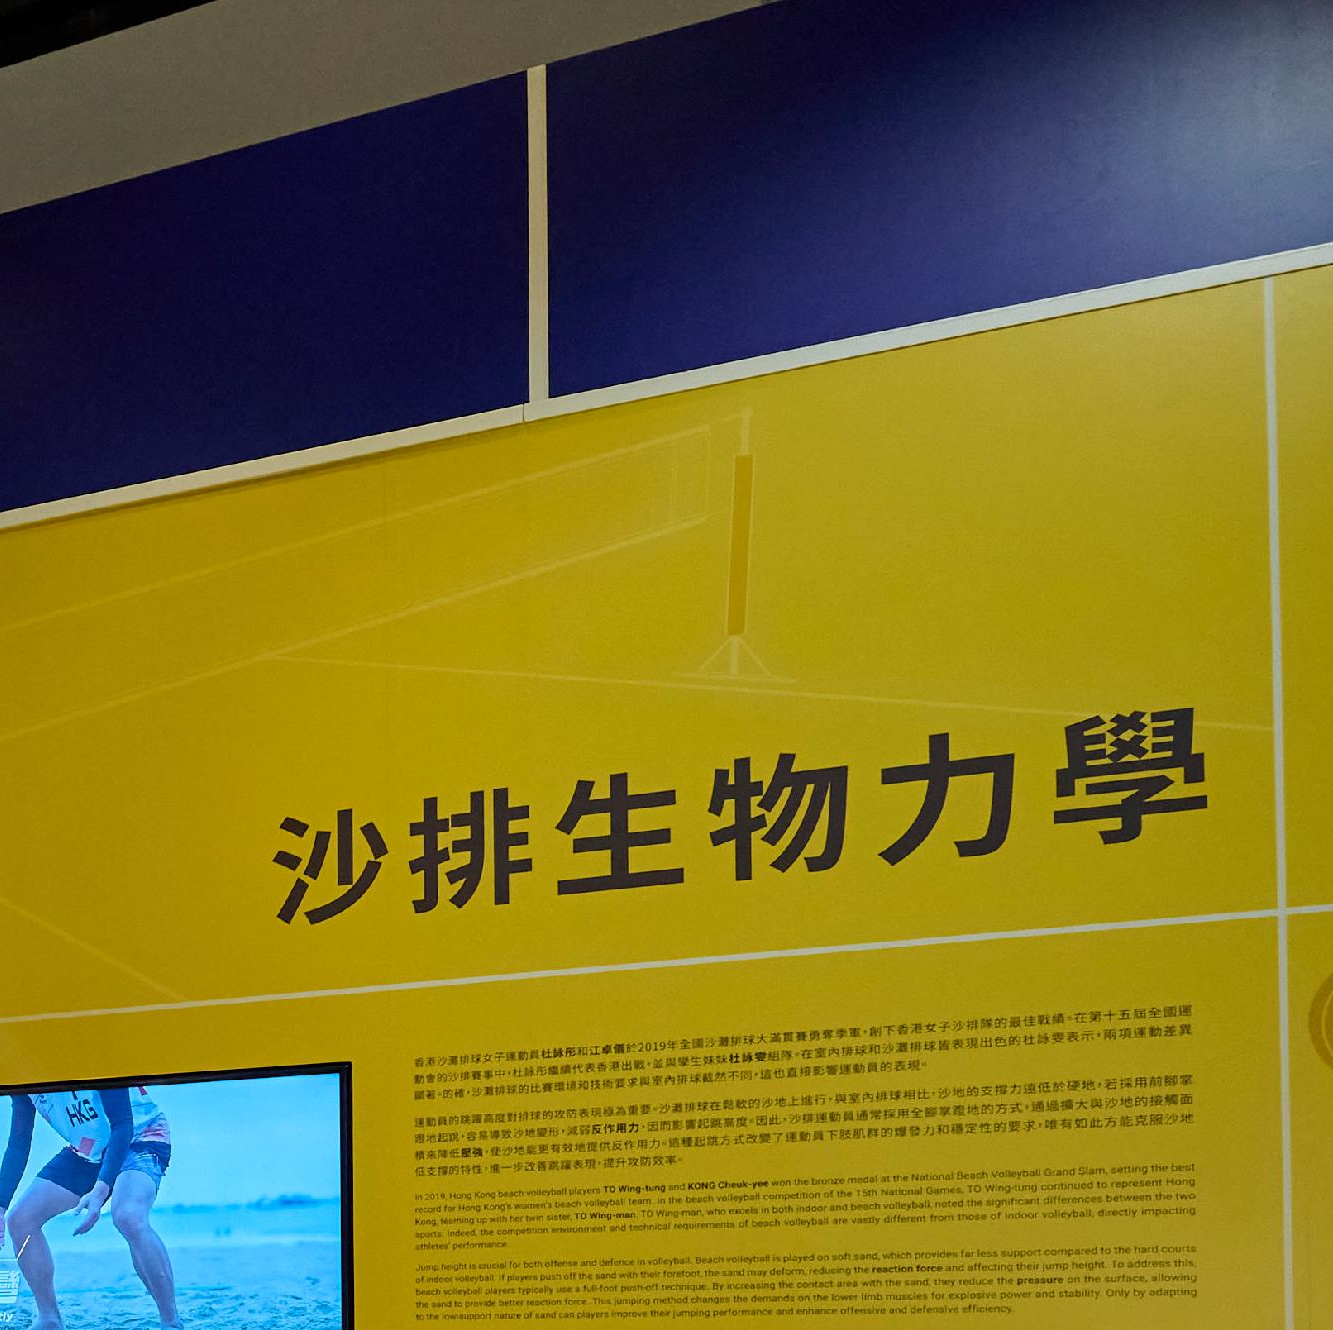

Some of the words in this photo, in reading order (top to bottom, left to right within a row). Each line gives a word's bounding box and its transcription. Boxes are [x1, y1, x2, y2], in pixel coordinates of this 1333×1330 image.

[271, 706, 1210, 927] 沙排生物力學
[65, 1098, 99, 1128] HKG
